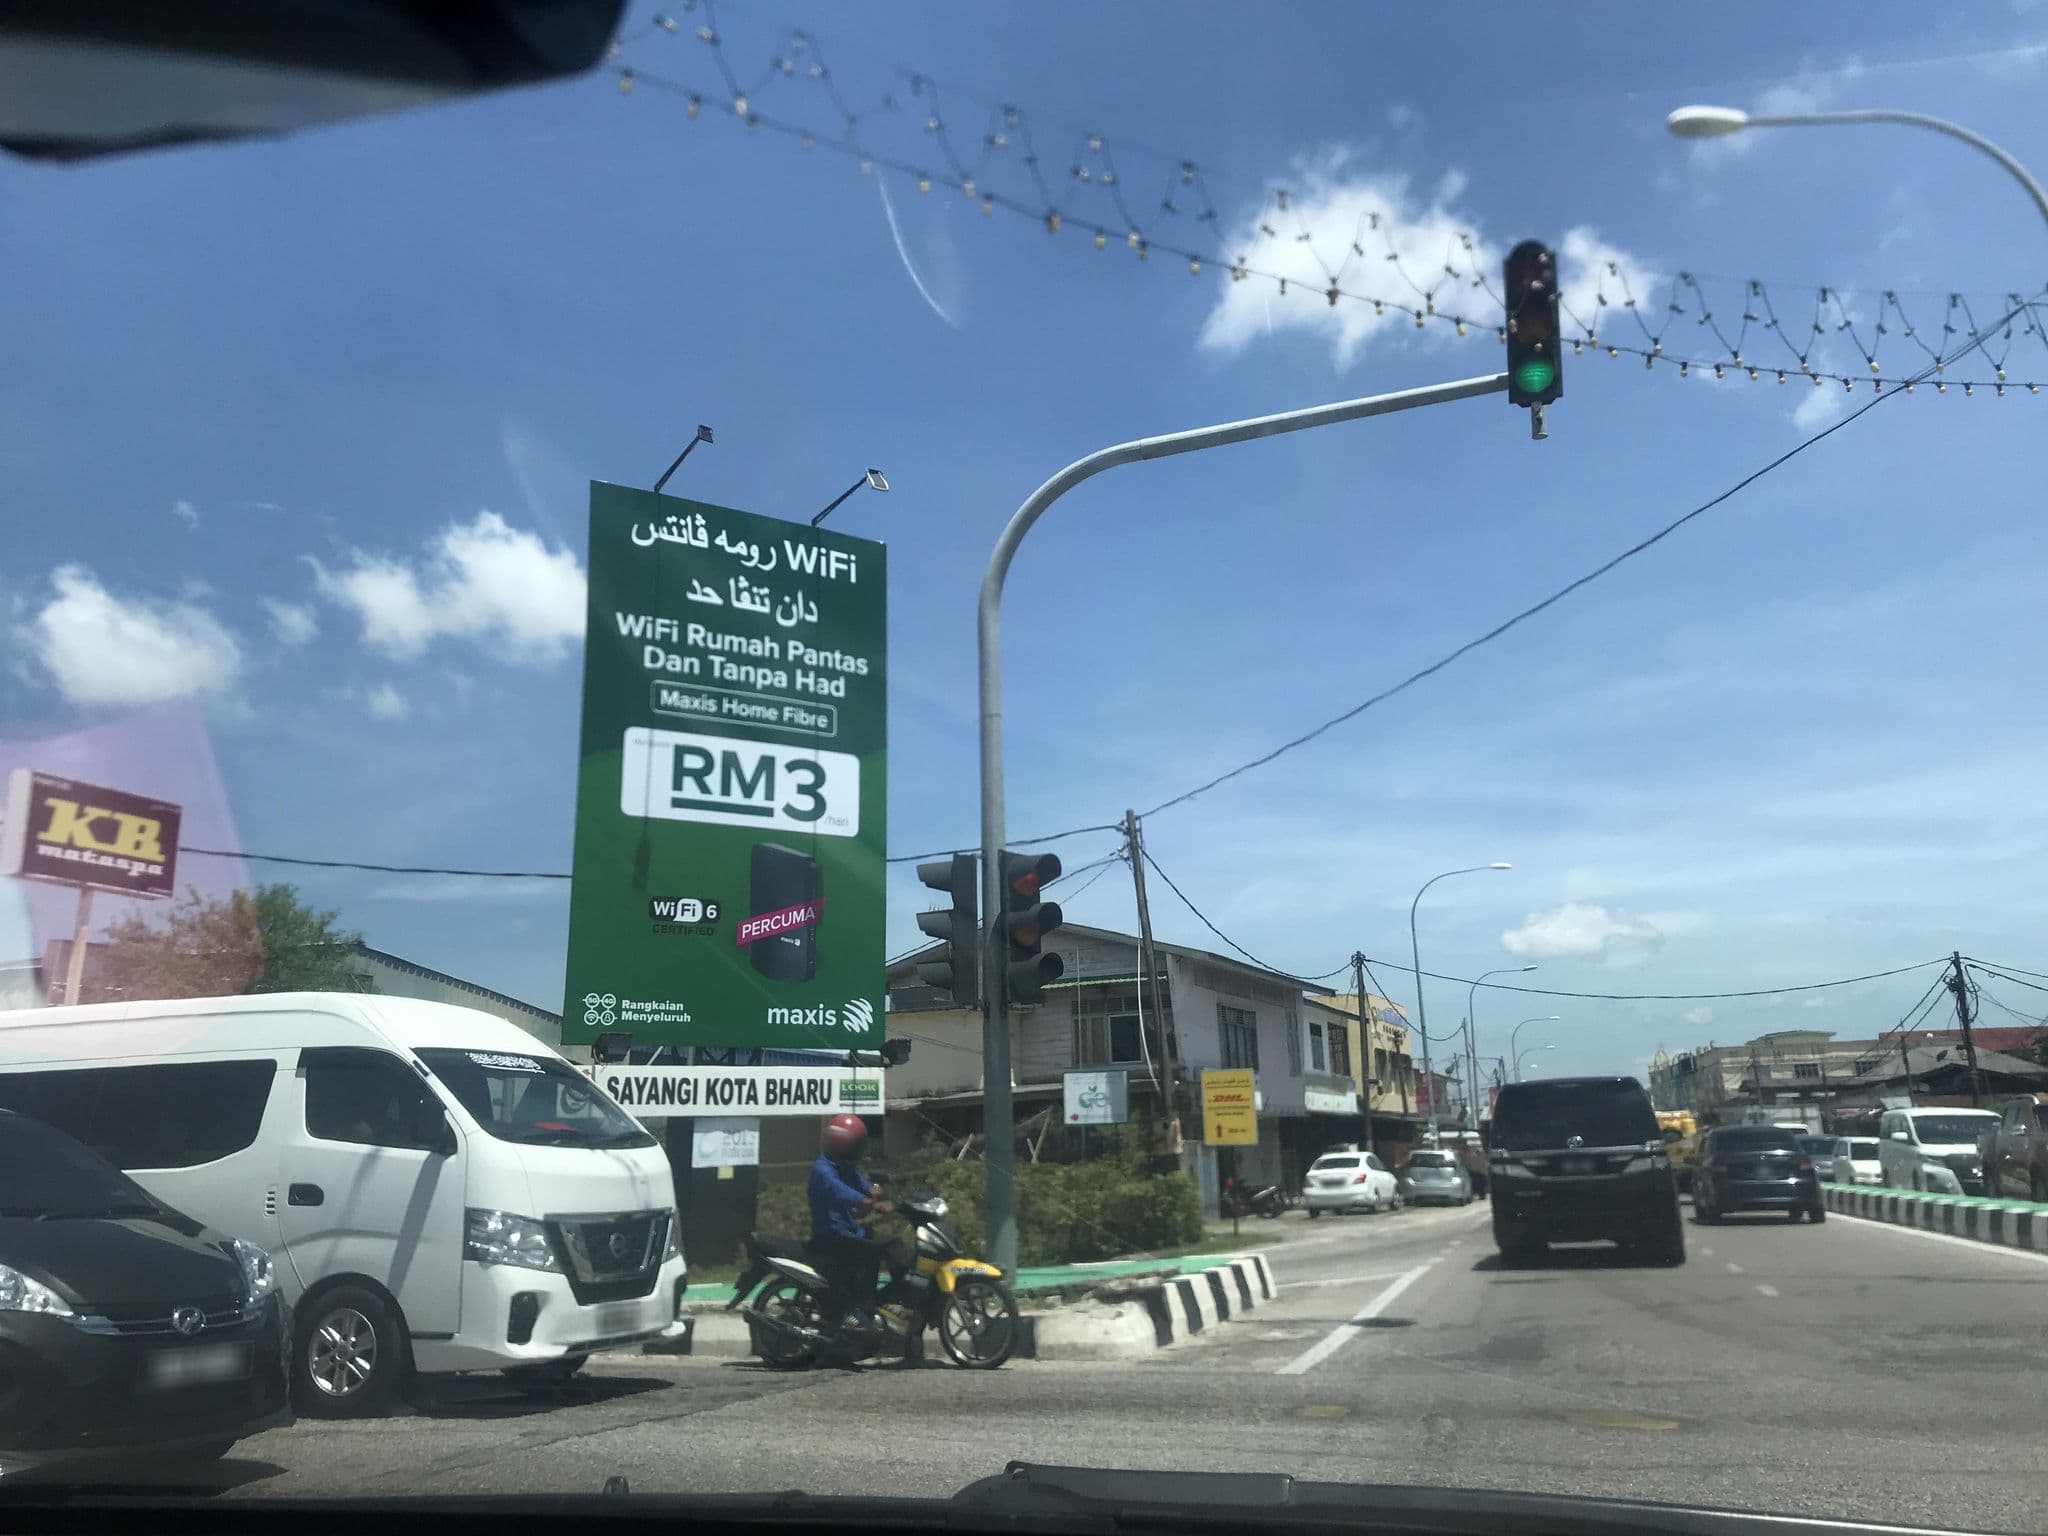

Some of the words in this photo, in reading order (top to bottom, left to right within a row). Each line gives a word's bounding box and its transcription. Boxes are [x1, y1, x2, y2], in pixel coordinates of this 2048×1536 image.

[714, 529, 777, 571] رومه
[783, 540, 857, 584] WiFi
[686, 579, 724, 606] حد
[775, 590, 818, 628] دان
[615, 611, 679, 643] WiFi
[687, 622, 780, 661] Rumah
[787, 639, 869, 675] Pantas
[643, 644, 701, 675] Dan
[707, 655, 788, 690] Tanpa
[795, 669, 846, 698] Had
[659, 689, 718, 713] Maxis
[721, 698, 778, 722] Home
[783, 706, 829, 729] Fibre
[38, 797, 166, 863] KB
[706, 904, 717, 919] 6
[742, 906, 815, 939] PERCUMA
[652, 923, 714, 937] CERTIFIED
[621, 999, 684, 1012] Rangkaian
[621, 1011, 691, 1023] Menyeluruh
[767, 1003, 837, 1026] maxis
[607, 1075, 699, 1106] SAYANGI
[705, 1077, 759, 1106] KOTA
[765, 1078, 833, 1106] BHARU
